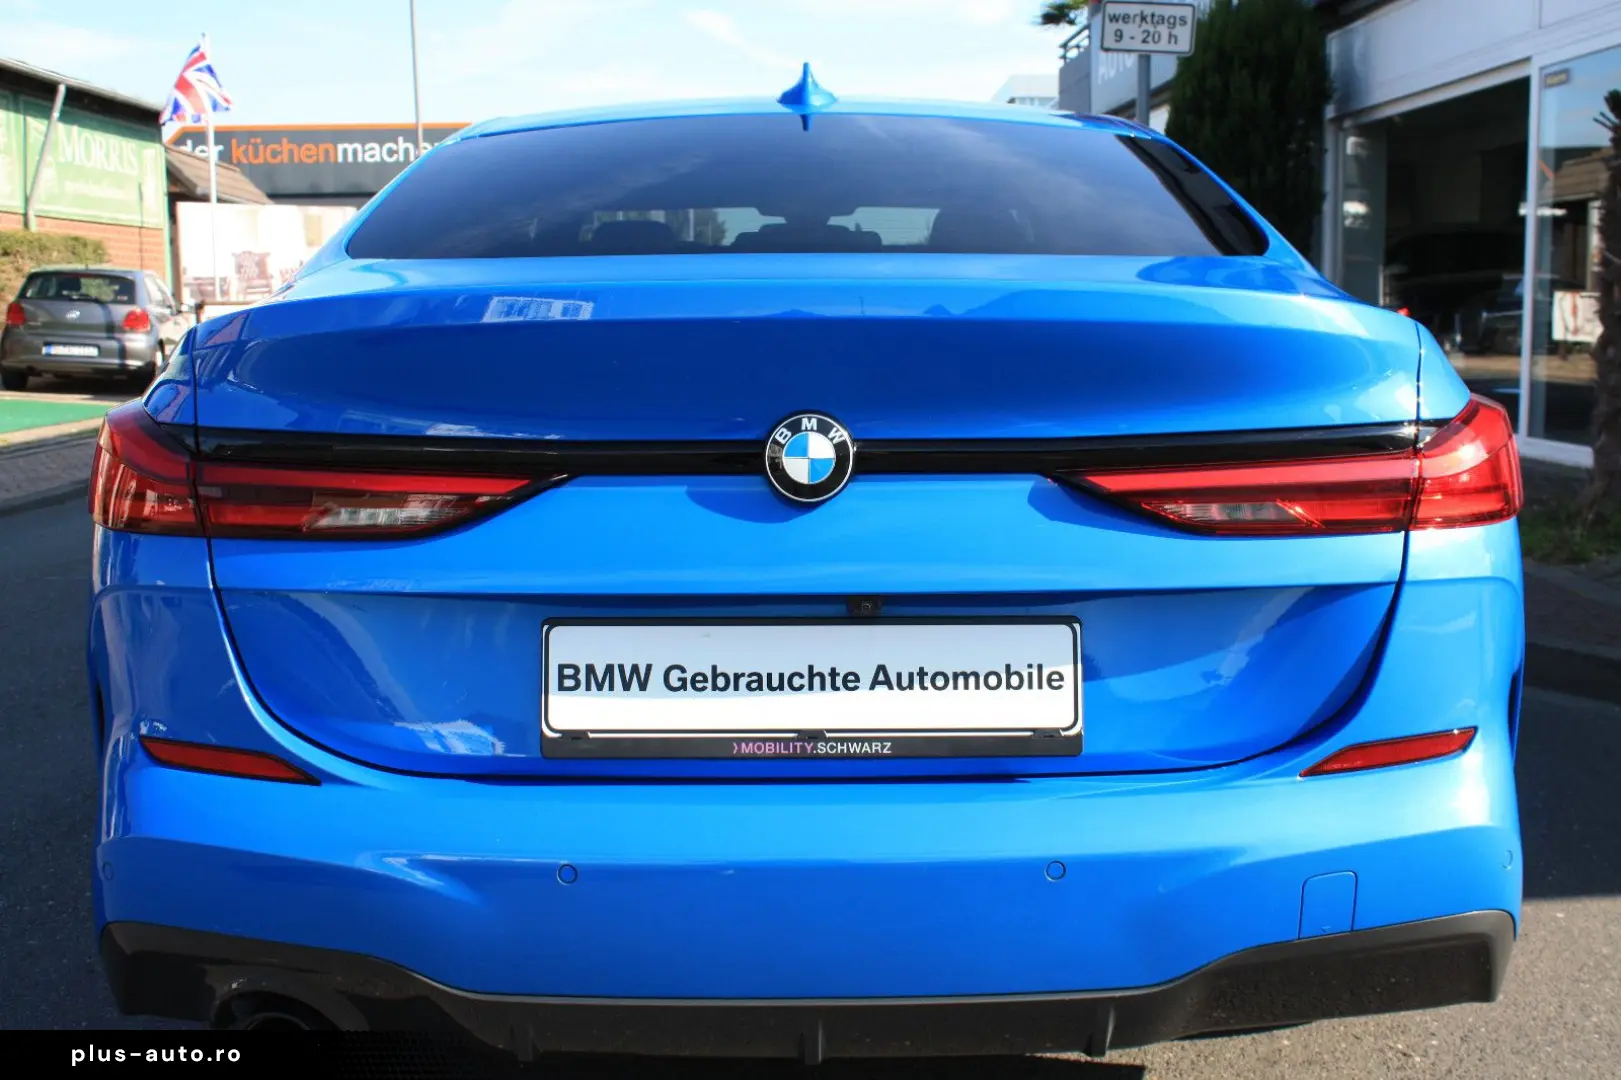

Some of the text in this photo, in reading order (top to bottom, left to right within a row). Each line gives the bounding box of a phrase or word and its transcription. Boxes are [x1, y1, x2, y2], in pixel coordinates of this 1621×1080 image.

[1108, 9, 1188, 29] werktags
[1114, 28, 1124, 43] 9
[1141, 29, 1161, 44] 20
[1168, 30, 1179, 45] h
[57, 121, 139, 175] MORRIS
[774, 417, 846, 444] BMW
[556, 663, 1065, 693] BMW Gebrauchte Automobile
